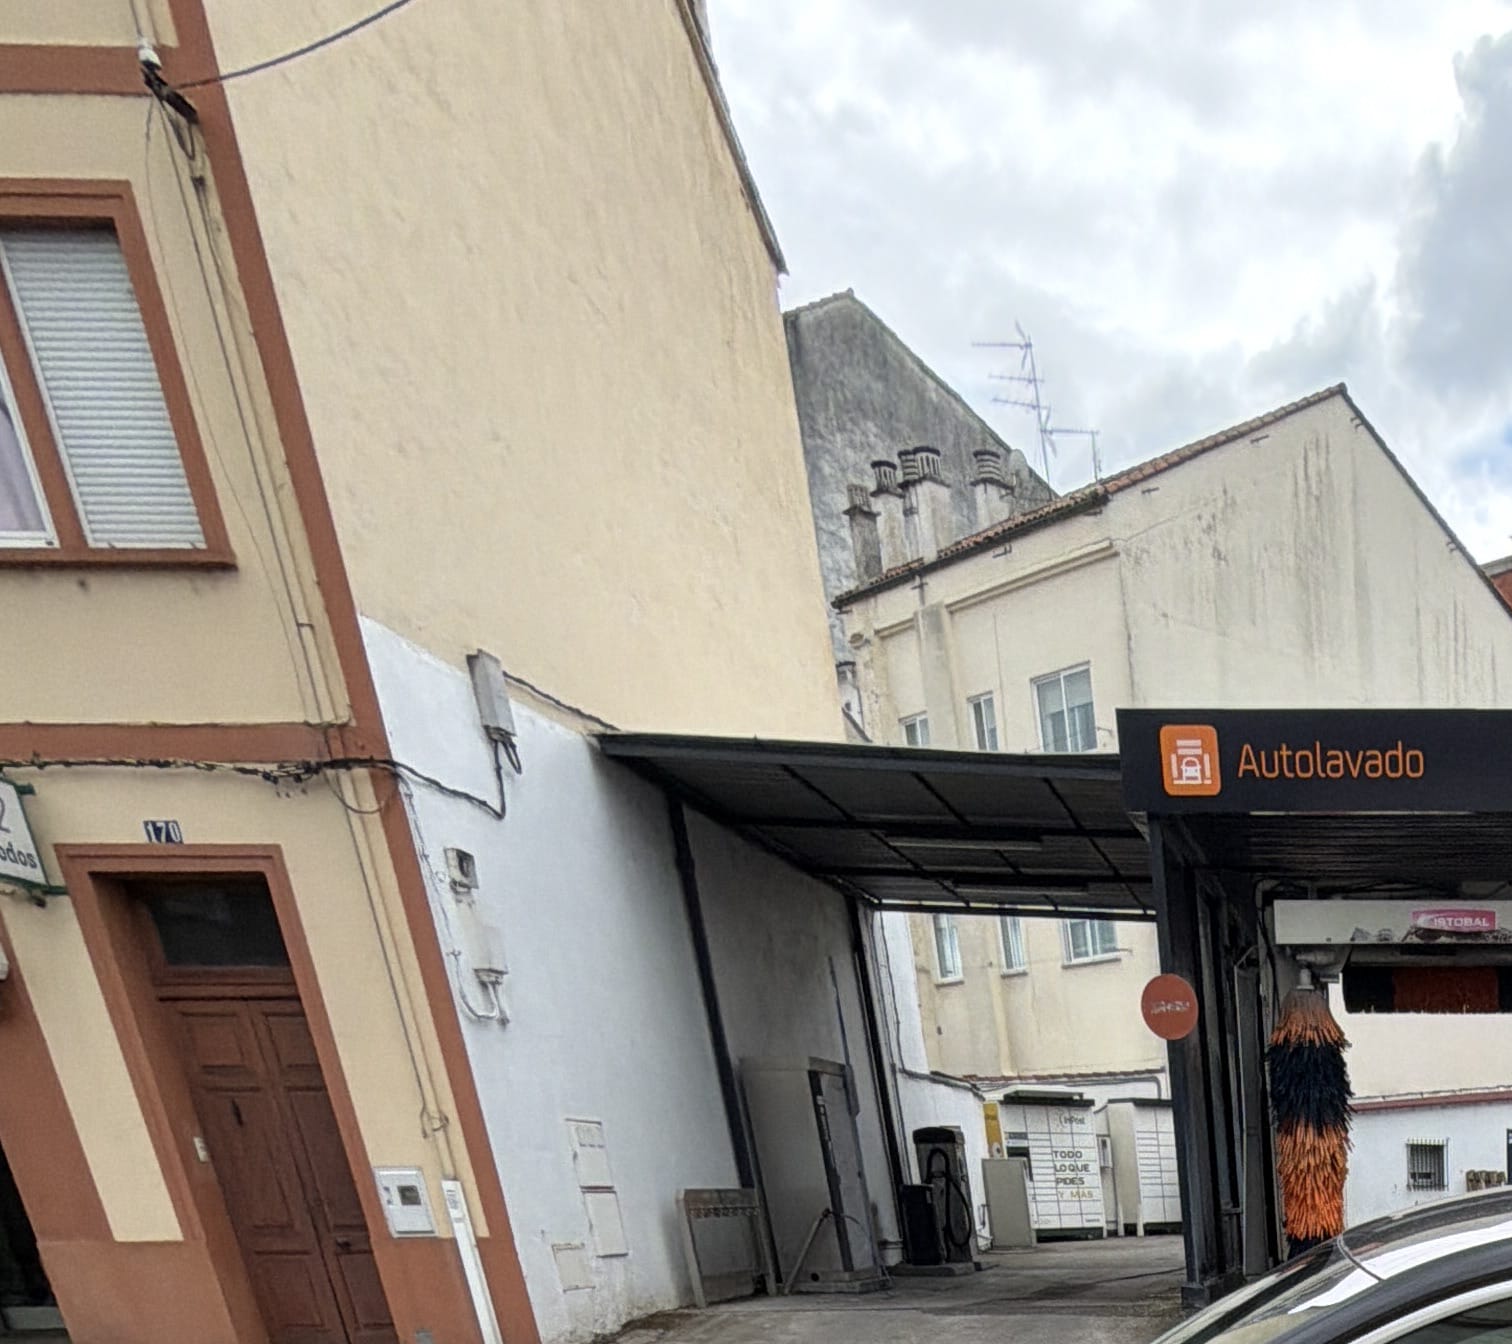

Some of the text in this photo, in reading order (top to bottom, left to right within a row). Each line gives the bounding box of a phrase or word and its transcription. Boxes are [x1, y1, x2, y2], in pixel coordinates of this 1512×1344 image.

[1237, 740, 1425, 779] Autolavado
[146, 821, 182, 843] 170
[1053, 1150, 1083, 1159] TODO
